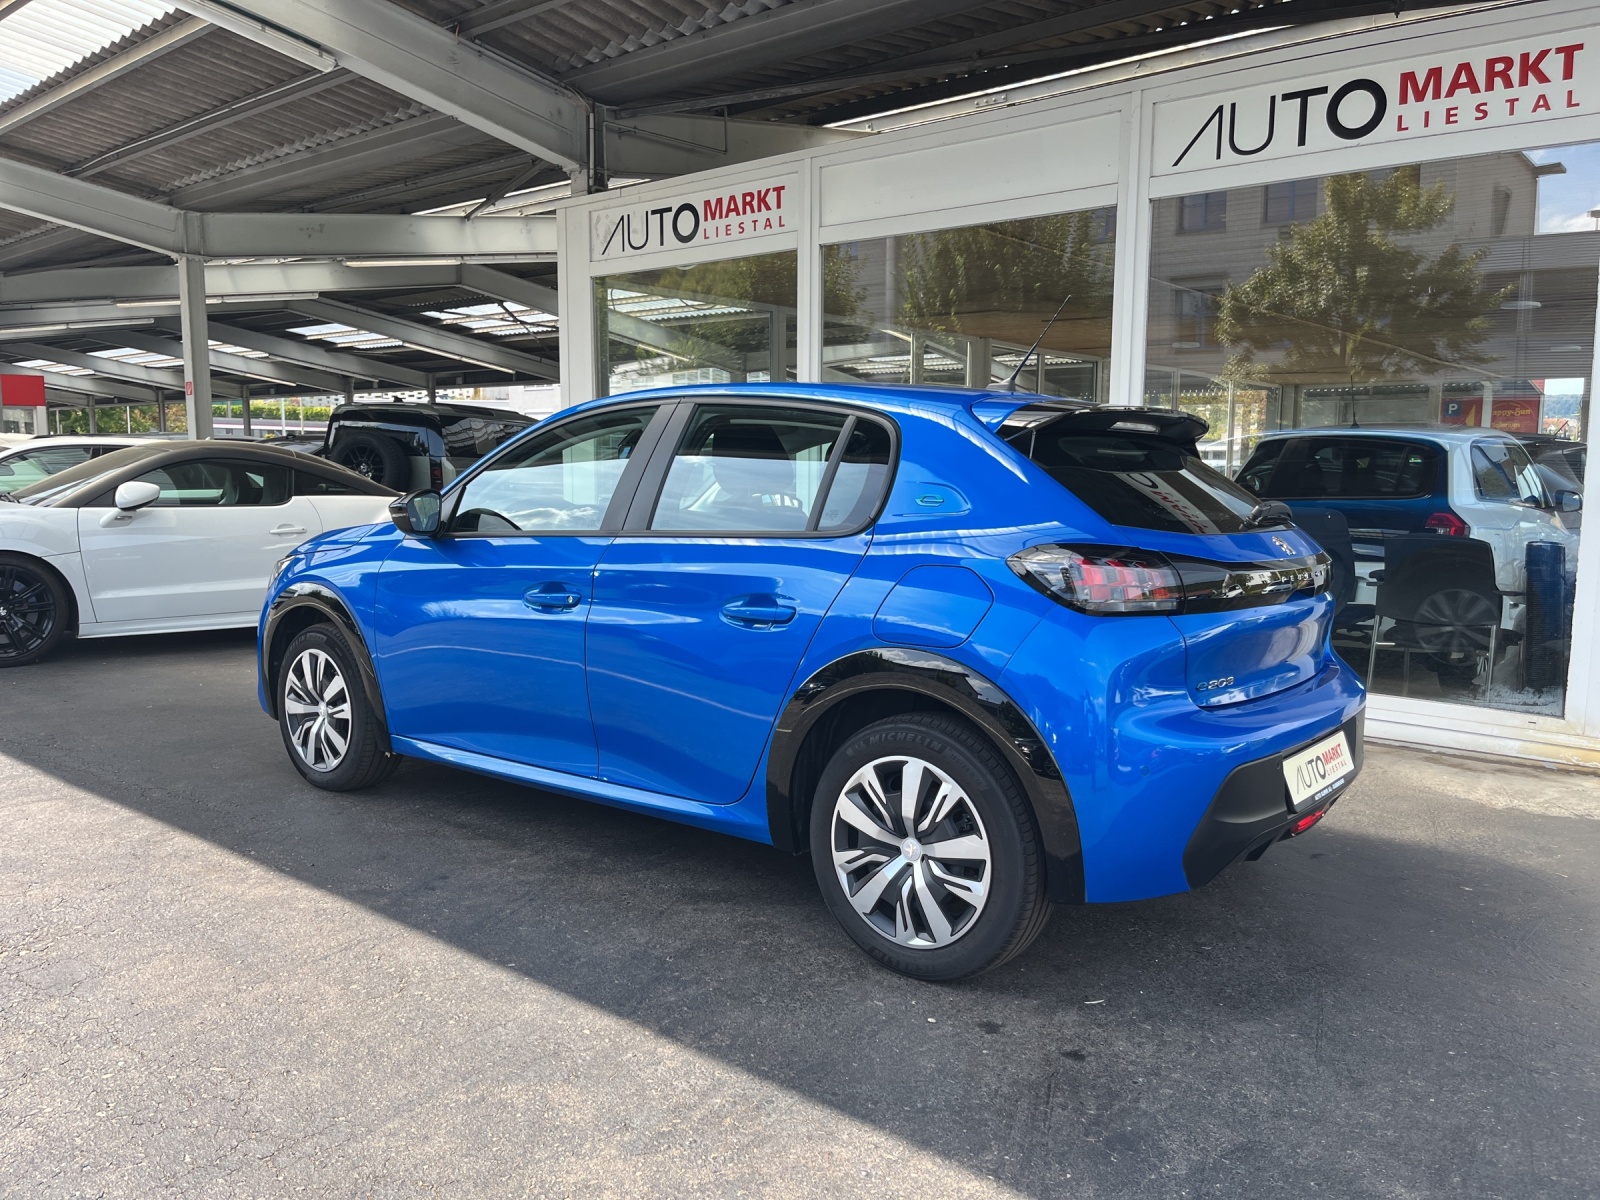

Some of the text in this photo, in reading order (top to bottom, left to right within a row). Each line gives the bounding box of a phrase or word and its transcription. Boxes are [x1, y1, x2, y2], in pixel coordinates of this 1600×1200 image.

[1172, 43, 1584, 167] AUTO MARKT
[1397, 89, 1581, 132] LIESTAL
[601, 185, 785, 255] AUTO MARKT
[703, 215, 785, 240] LIESTAL
[1449, 404, 1458, 414] P
[869, 732, 943, 751] MICHELIN
[1297, 755, 1326, 794] AUTO
[1322, 743, 1343, 766] MARKT
[1326, 759, 1347, 776] LIESTAL
